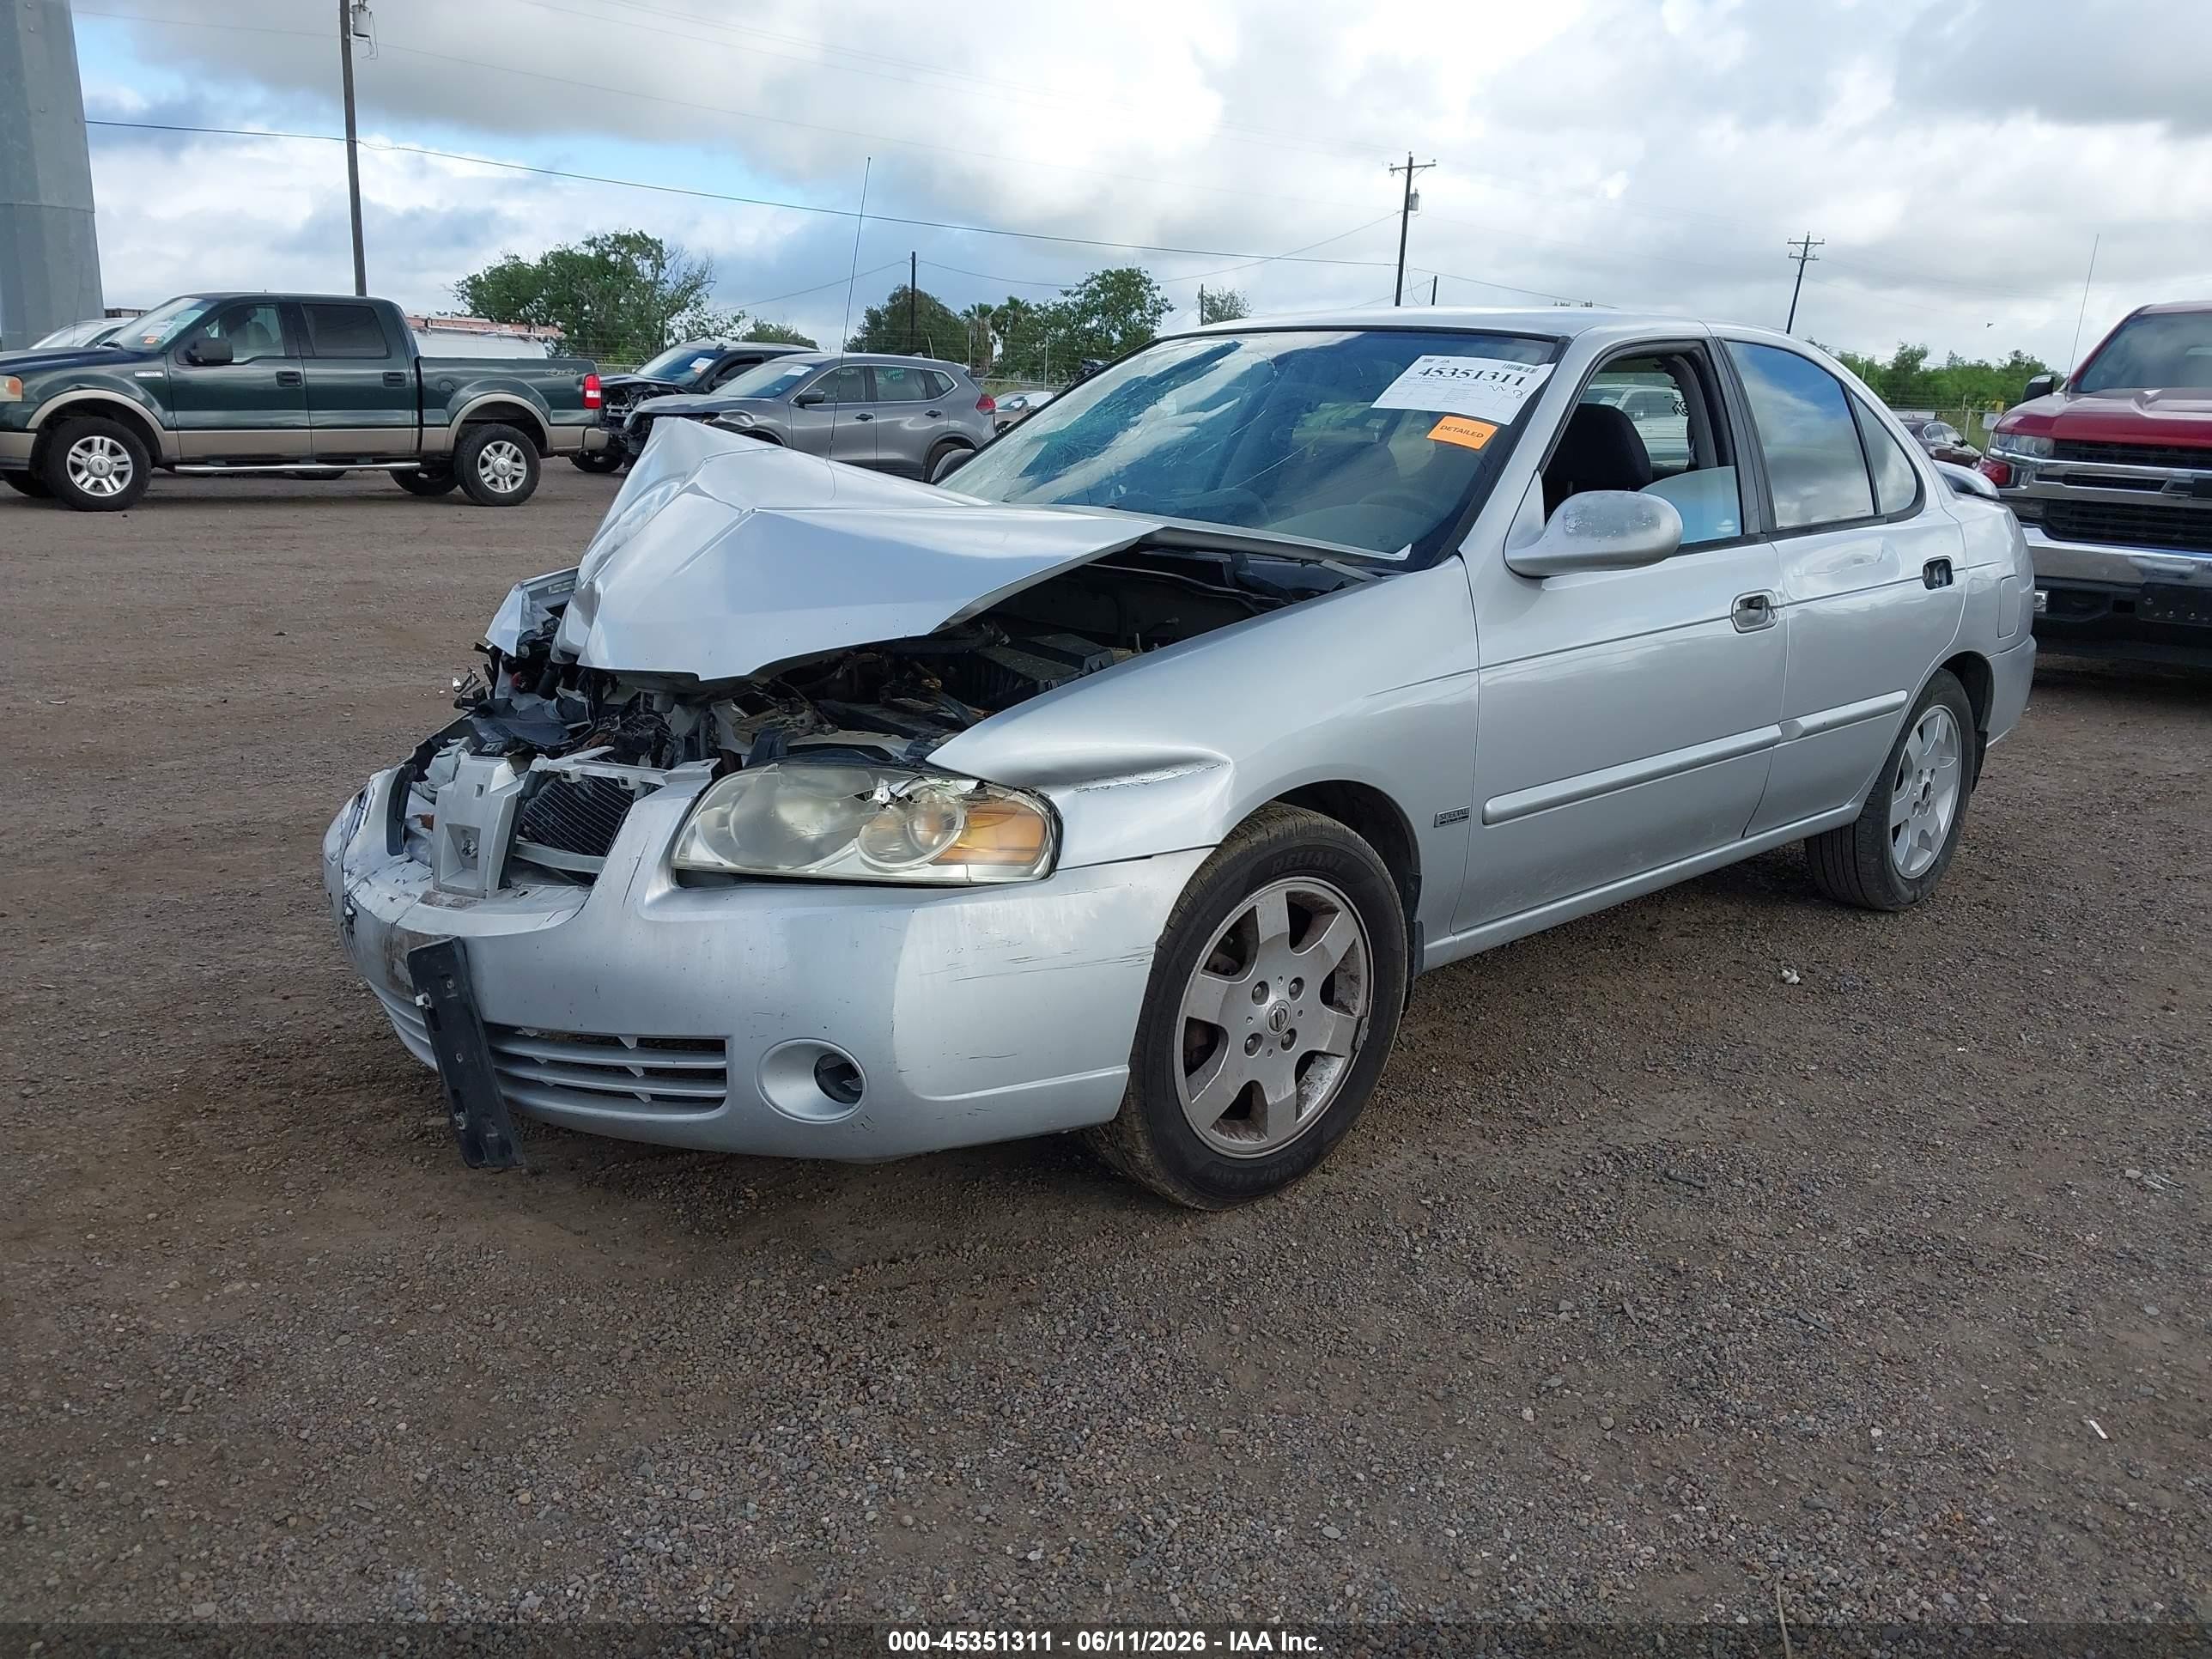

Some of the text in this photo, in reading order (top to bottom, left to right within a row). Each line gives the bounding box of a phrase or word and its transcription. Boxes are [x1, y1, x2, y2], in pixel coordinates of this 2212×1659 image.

[1418, 366, 1527, 386] 45351311
[1439, 425, 1485, 438] DETAILED
[1271, 850, 1347, 876] RELIANT
